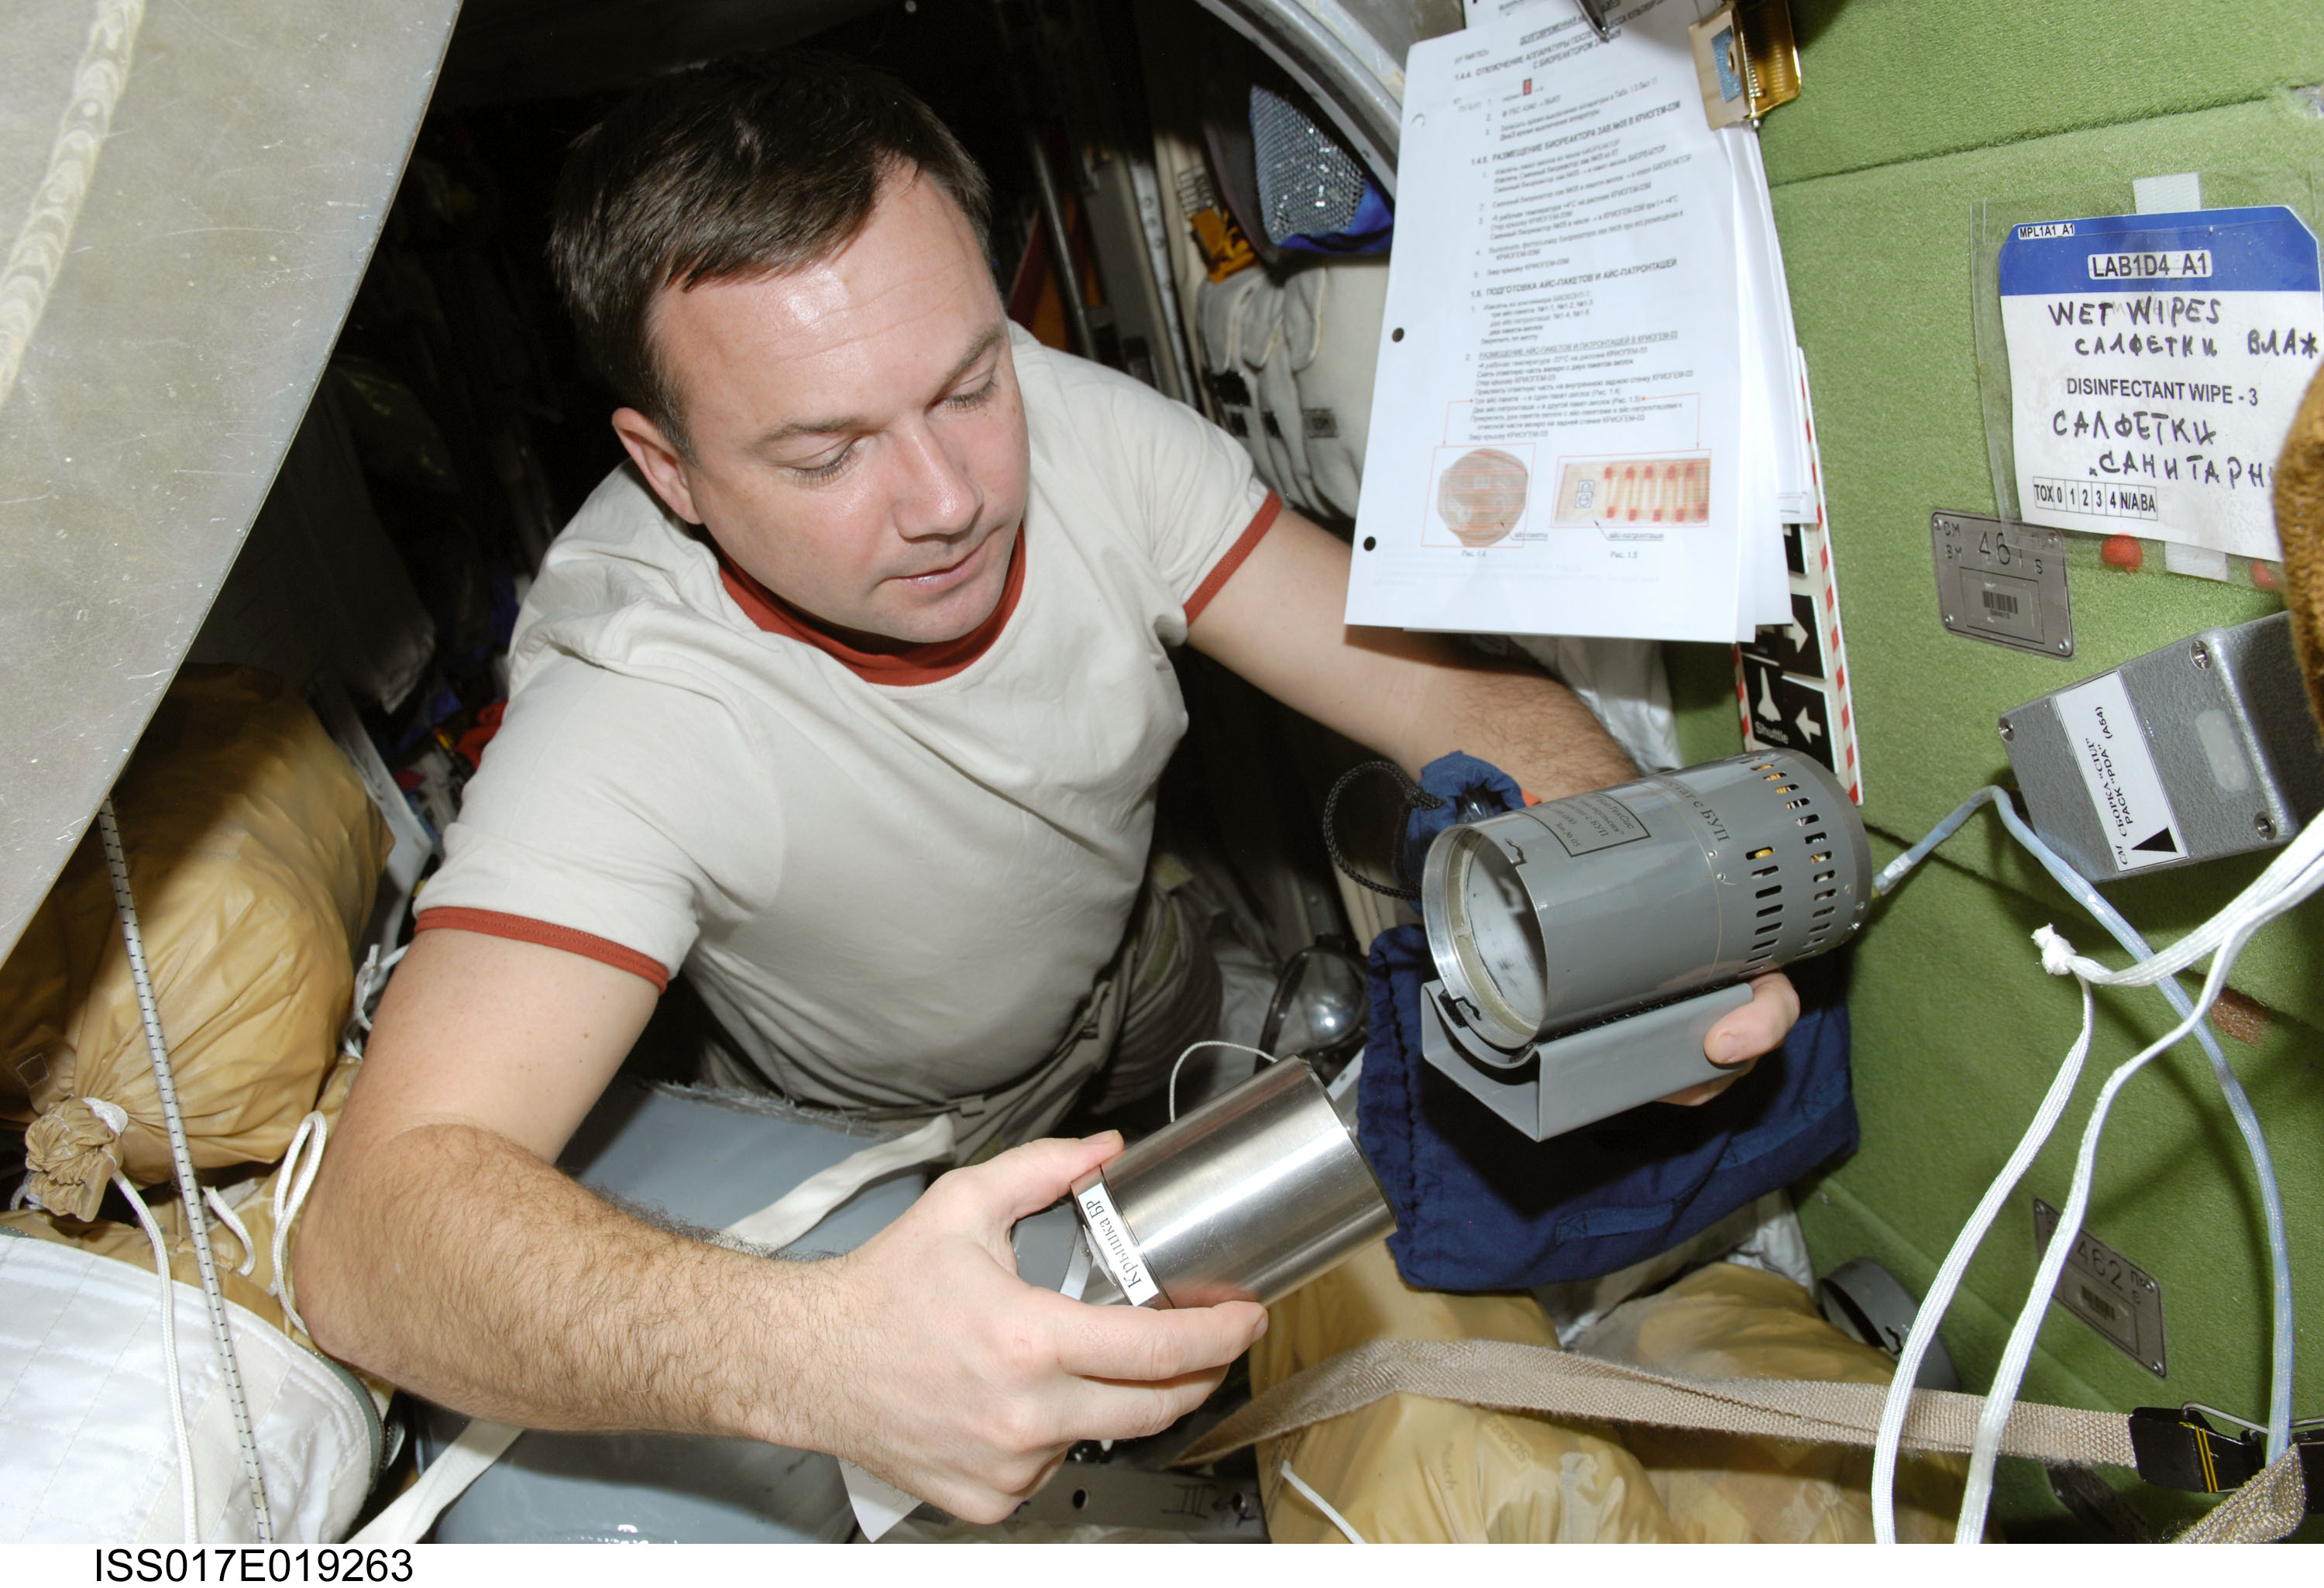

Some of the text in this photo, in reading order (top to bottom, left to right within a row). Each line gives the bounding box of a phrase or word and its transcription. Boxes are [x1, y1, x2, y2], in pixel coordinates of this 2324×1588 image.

[2047, 295, 2221, 328] WET WIPES
[2075, 332, 2218, 358] САЛФЕТКИ
[2068, 378, 2185, 401] DISINFECTANT
[2188, 383, 2233, 404] WIPE
[2248, 387, 2258, 407] 3
[2053, 409, 2216, 445] САЛФЕТКИ
[2034, 484, 2156, 513] TOX 0 1 2 3 4 N/A BA
[1753, 720, 1789, 745] Shuttle
[2095, 706, 2113, 740] (A54)
[2103, 782, 2127, 837] СБОРКА
[2114, 786, 2133, 825] PACK
[1700, 809, 1730, 842] БУП
[1100, 1217, 1143, 1289] Крышка
[2078, 1240, 2123, 1291] 462
